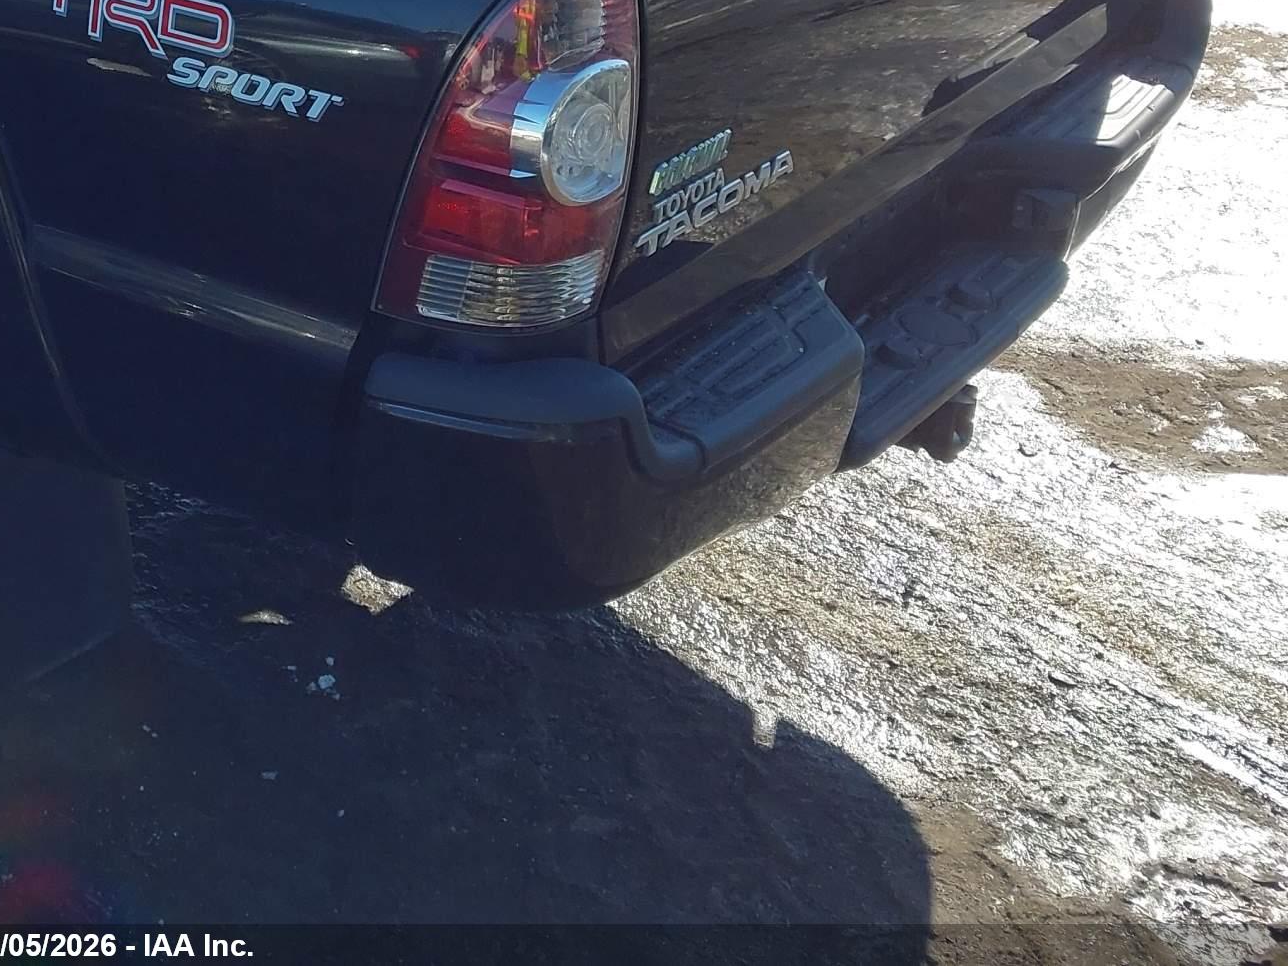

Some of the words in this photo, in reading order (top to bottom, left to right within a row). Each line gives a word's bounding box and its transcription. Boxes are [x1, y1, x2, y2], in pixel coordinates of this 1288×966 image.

[166, 56, 342, 122] SPORT
[634, 150, 794, 257] TACOMA
[654, 167, 726, 224] TOYOTA
